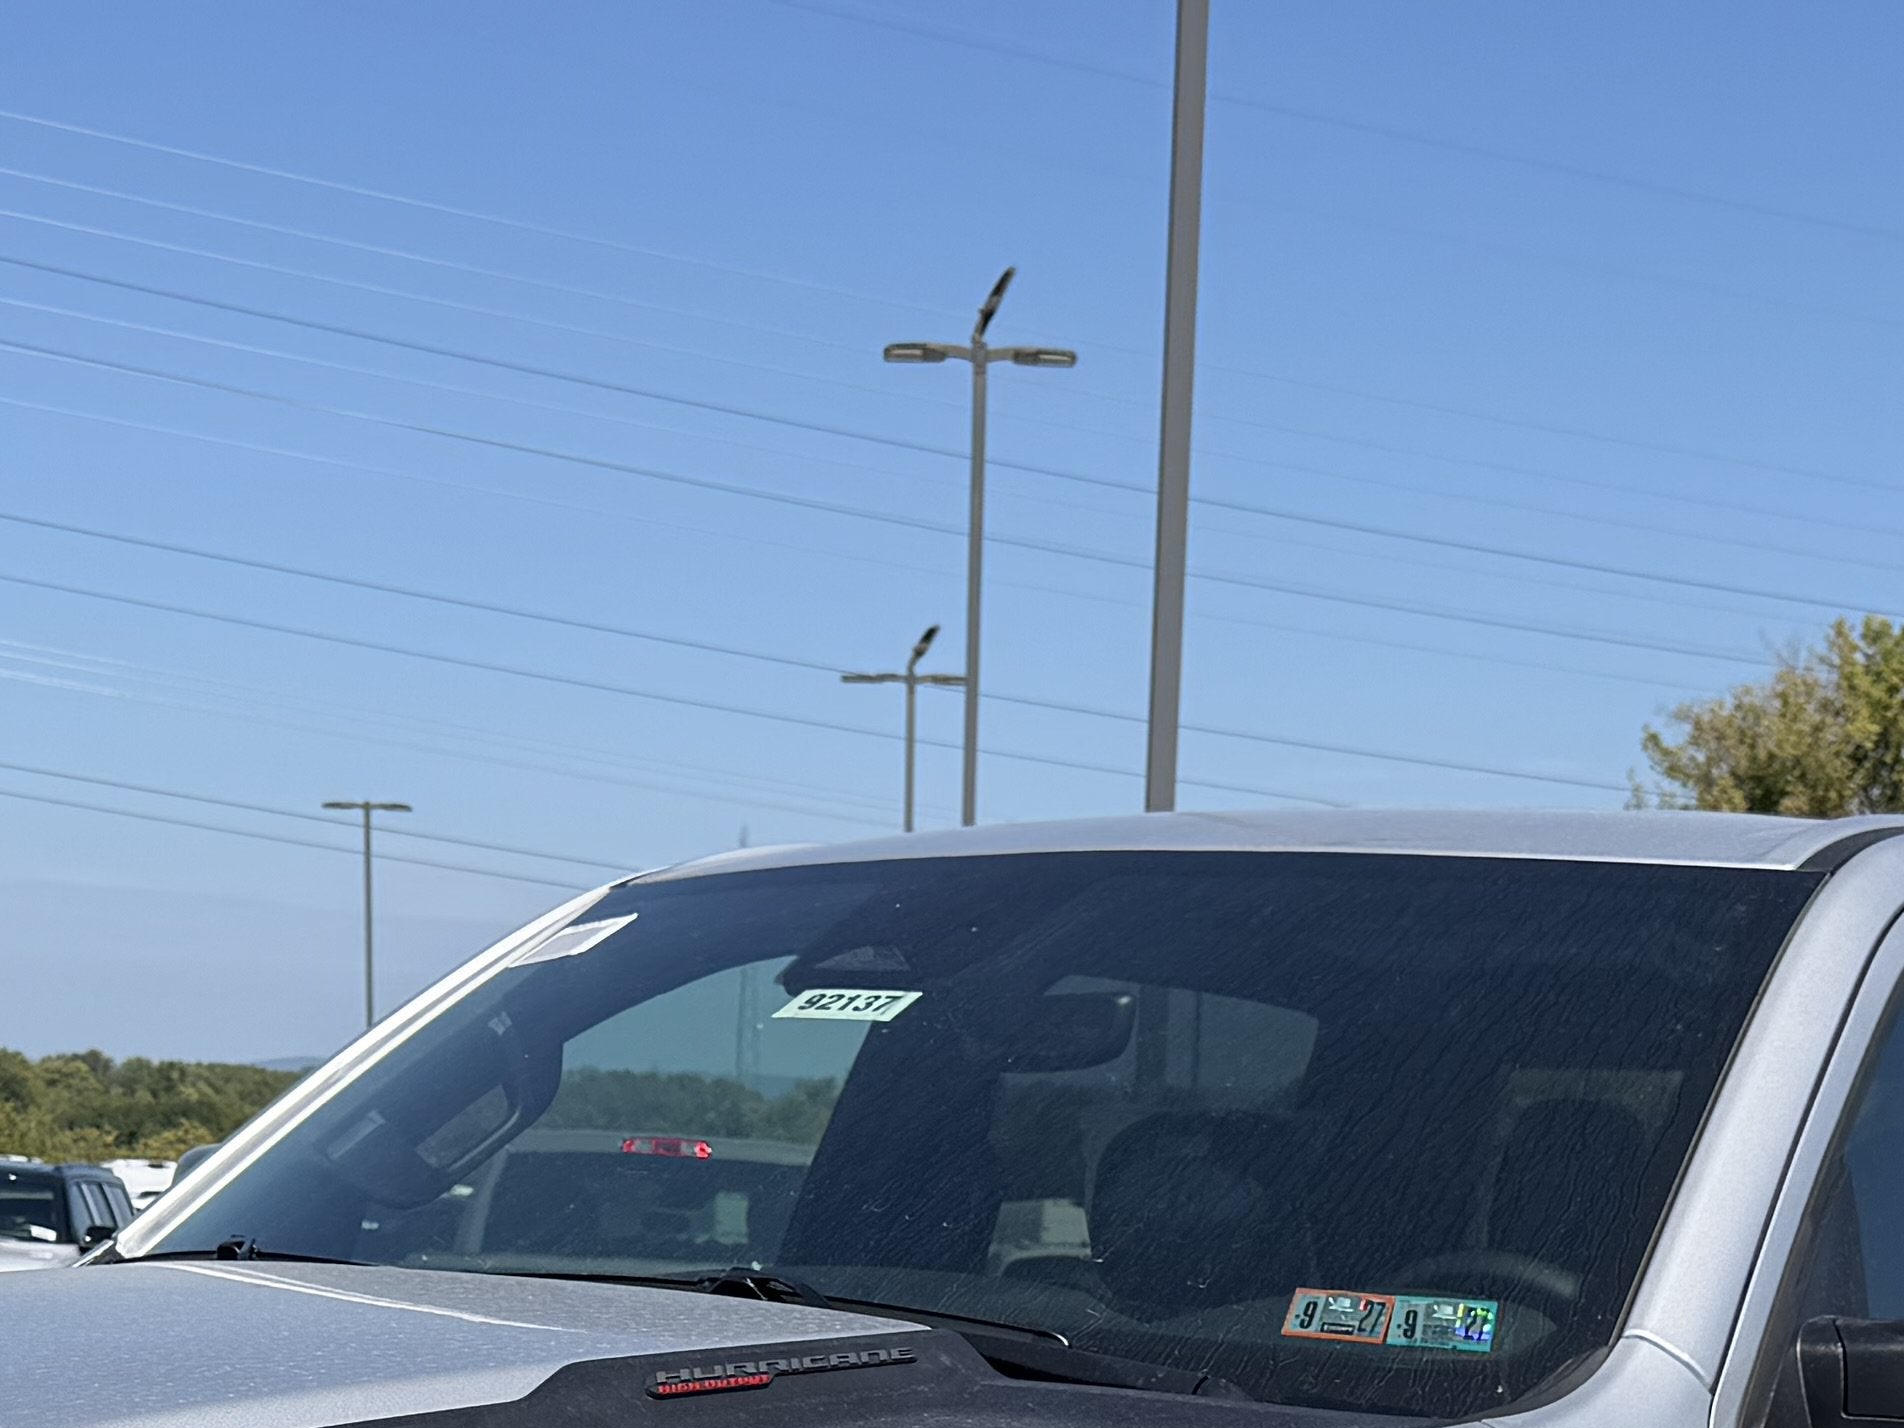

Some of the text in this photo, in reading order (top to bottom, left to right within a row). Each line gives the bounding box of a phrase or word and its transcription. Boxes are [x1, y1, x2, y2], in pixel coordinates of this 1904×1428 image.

[797, 993, 904, 1013] 92137
[1299, 1300, 1319, 1329] 9
[1357, 1299, 1387, 1336] 27
[1402, 1309, 1418, 1339] 9
[656, 1347, 916, 1383] HURRICANE
